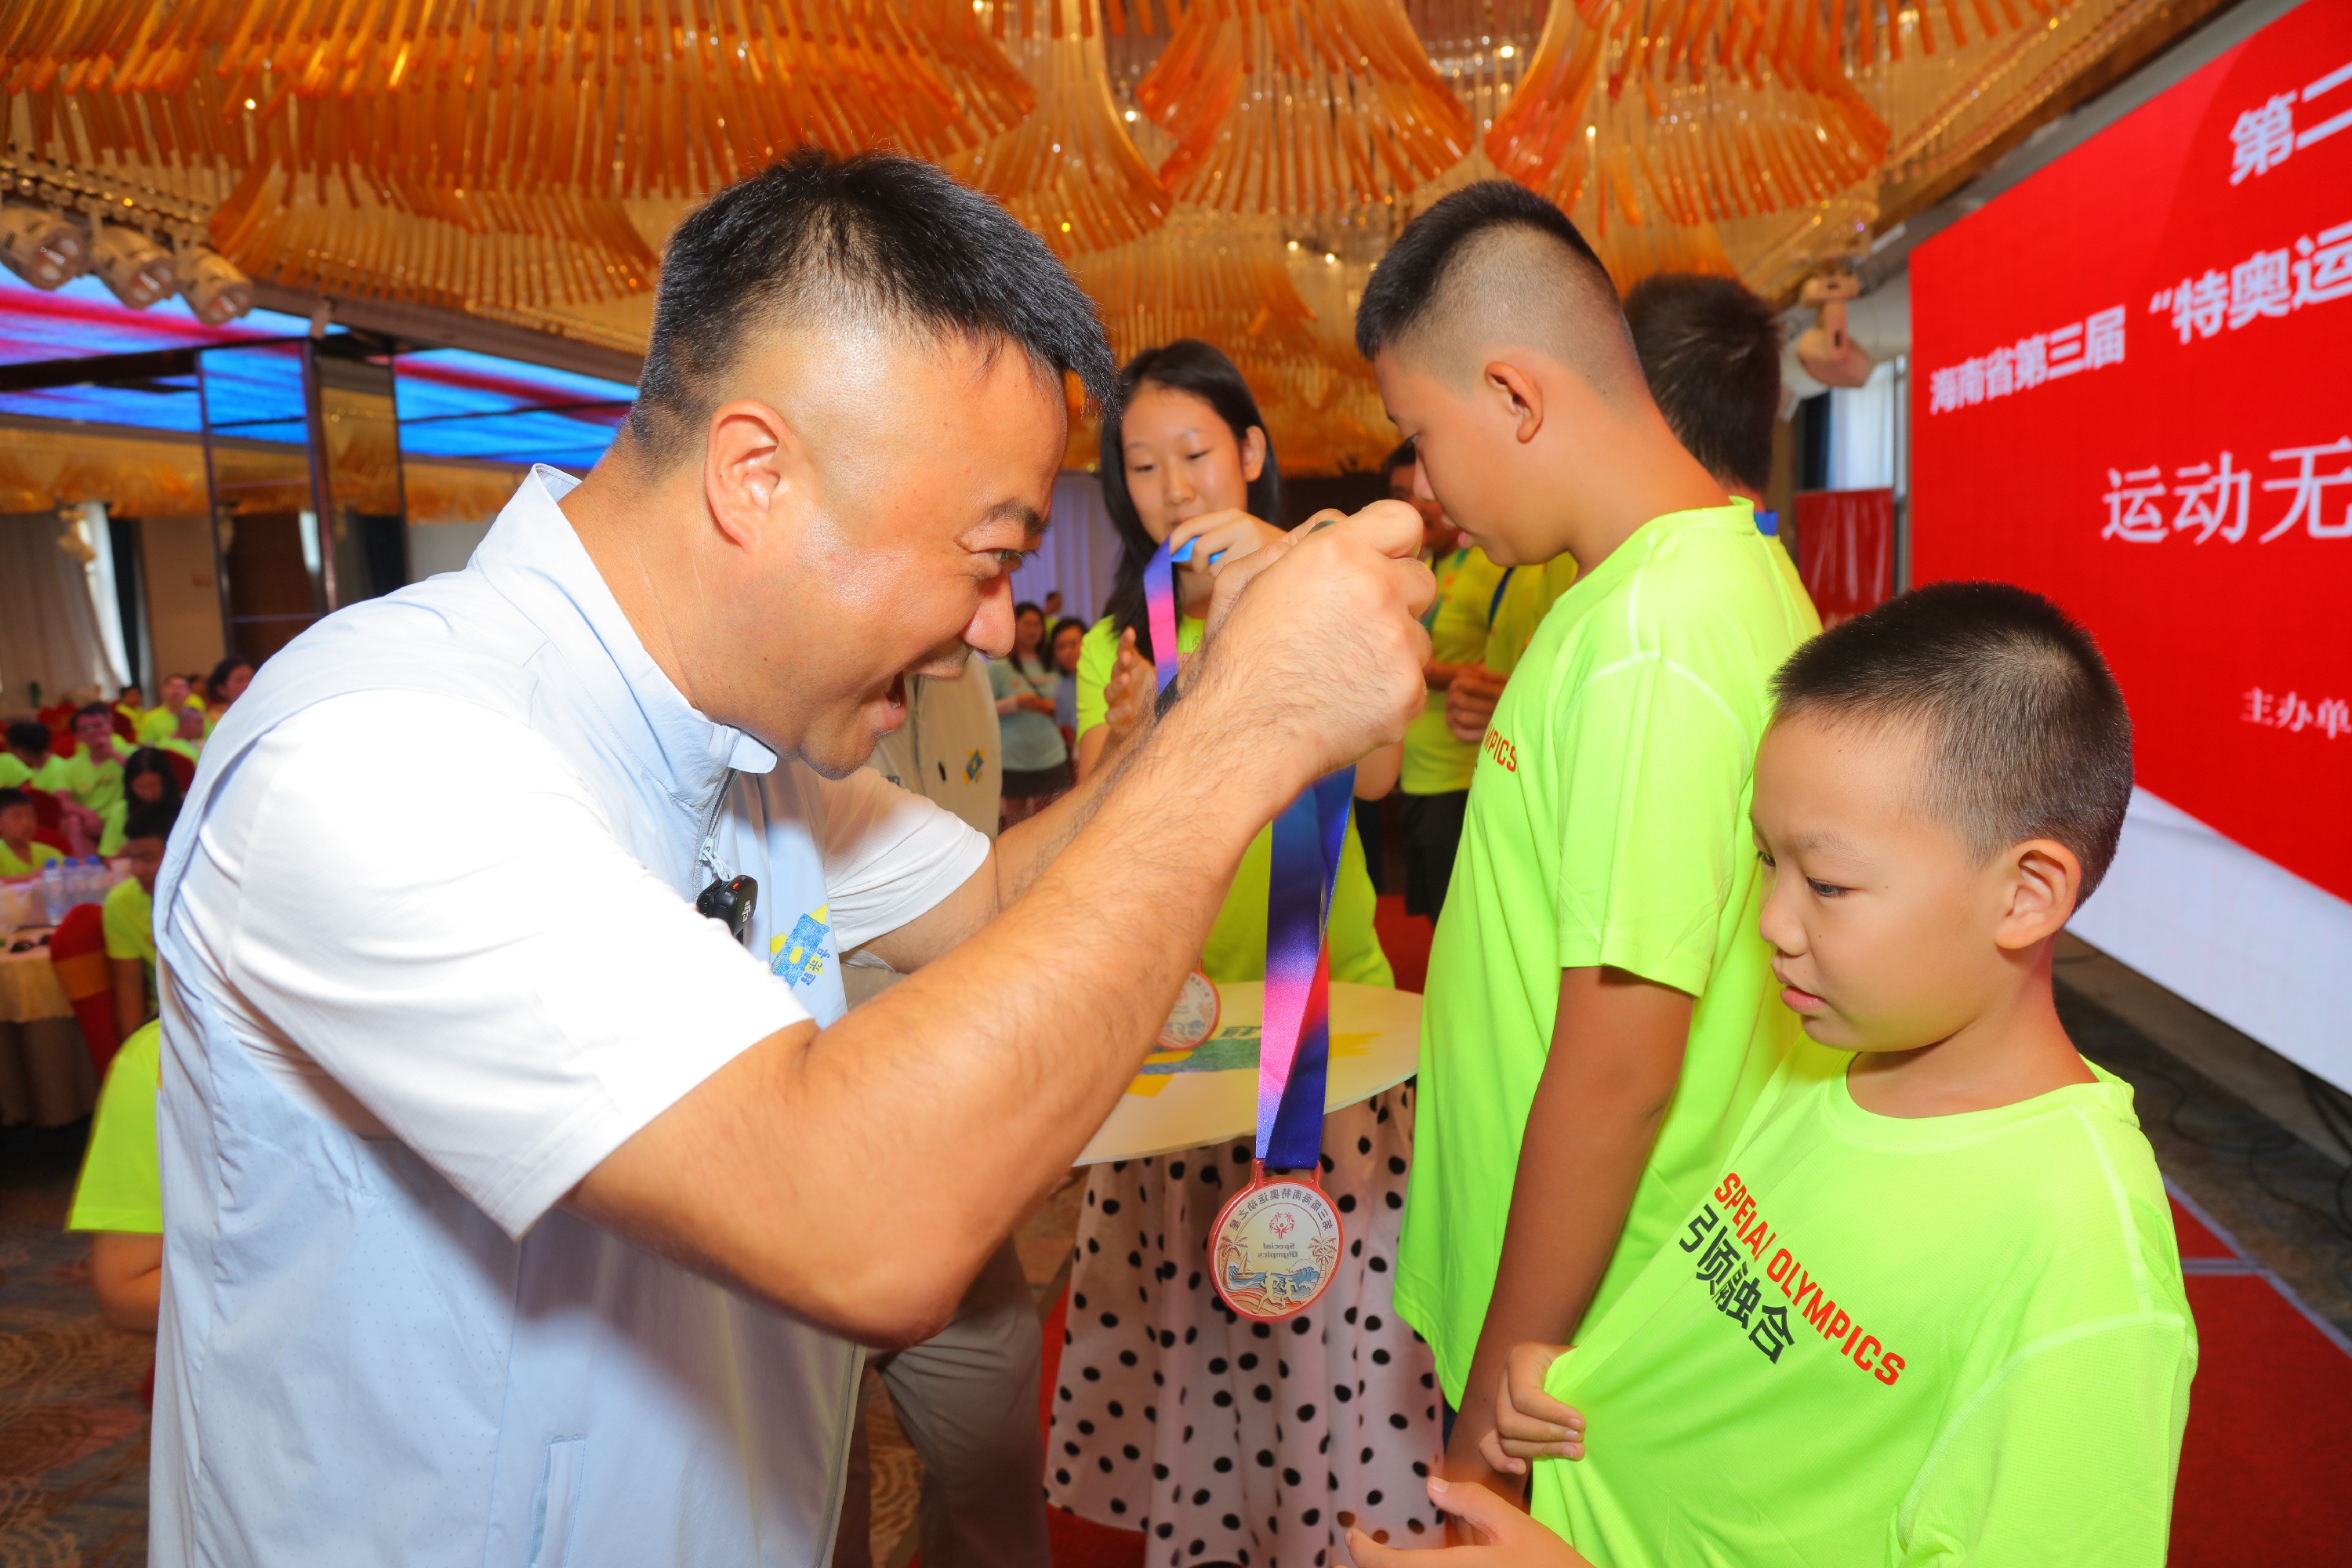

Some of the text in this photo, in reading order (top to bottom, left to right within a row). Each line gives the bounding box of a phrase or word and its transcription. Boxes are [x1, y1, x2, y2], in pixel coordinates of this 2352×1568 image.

[2102, 437, 2352, 544] 运动无
[2241, 687, 2352, 739] 主办单
[1766, 1248, 1906, 1386] OLYMPICS
